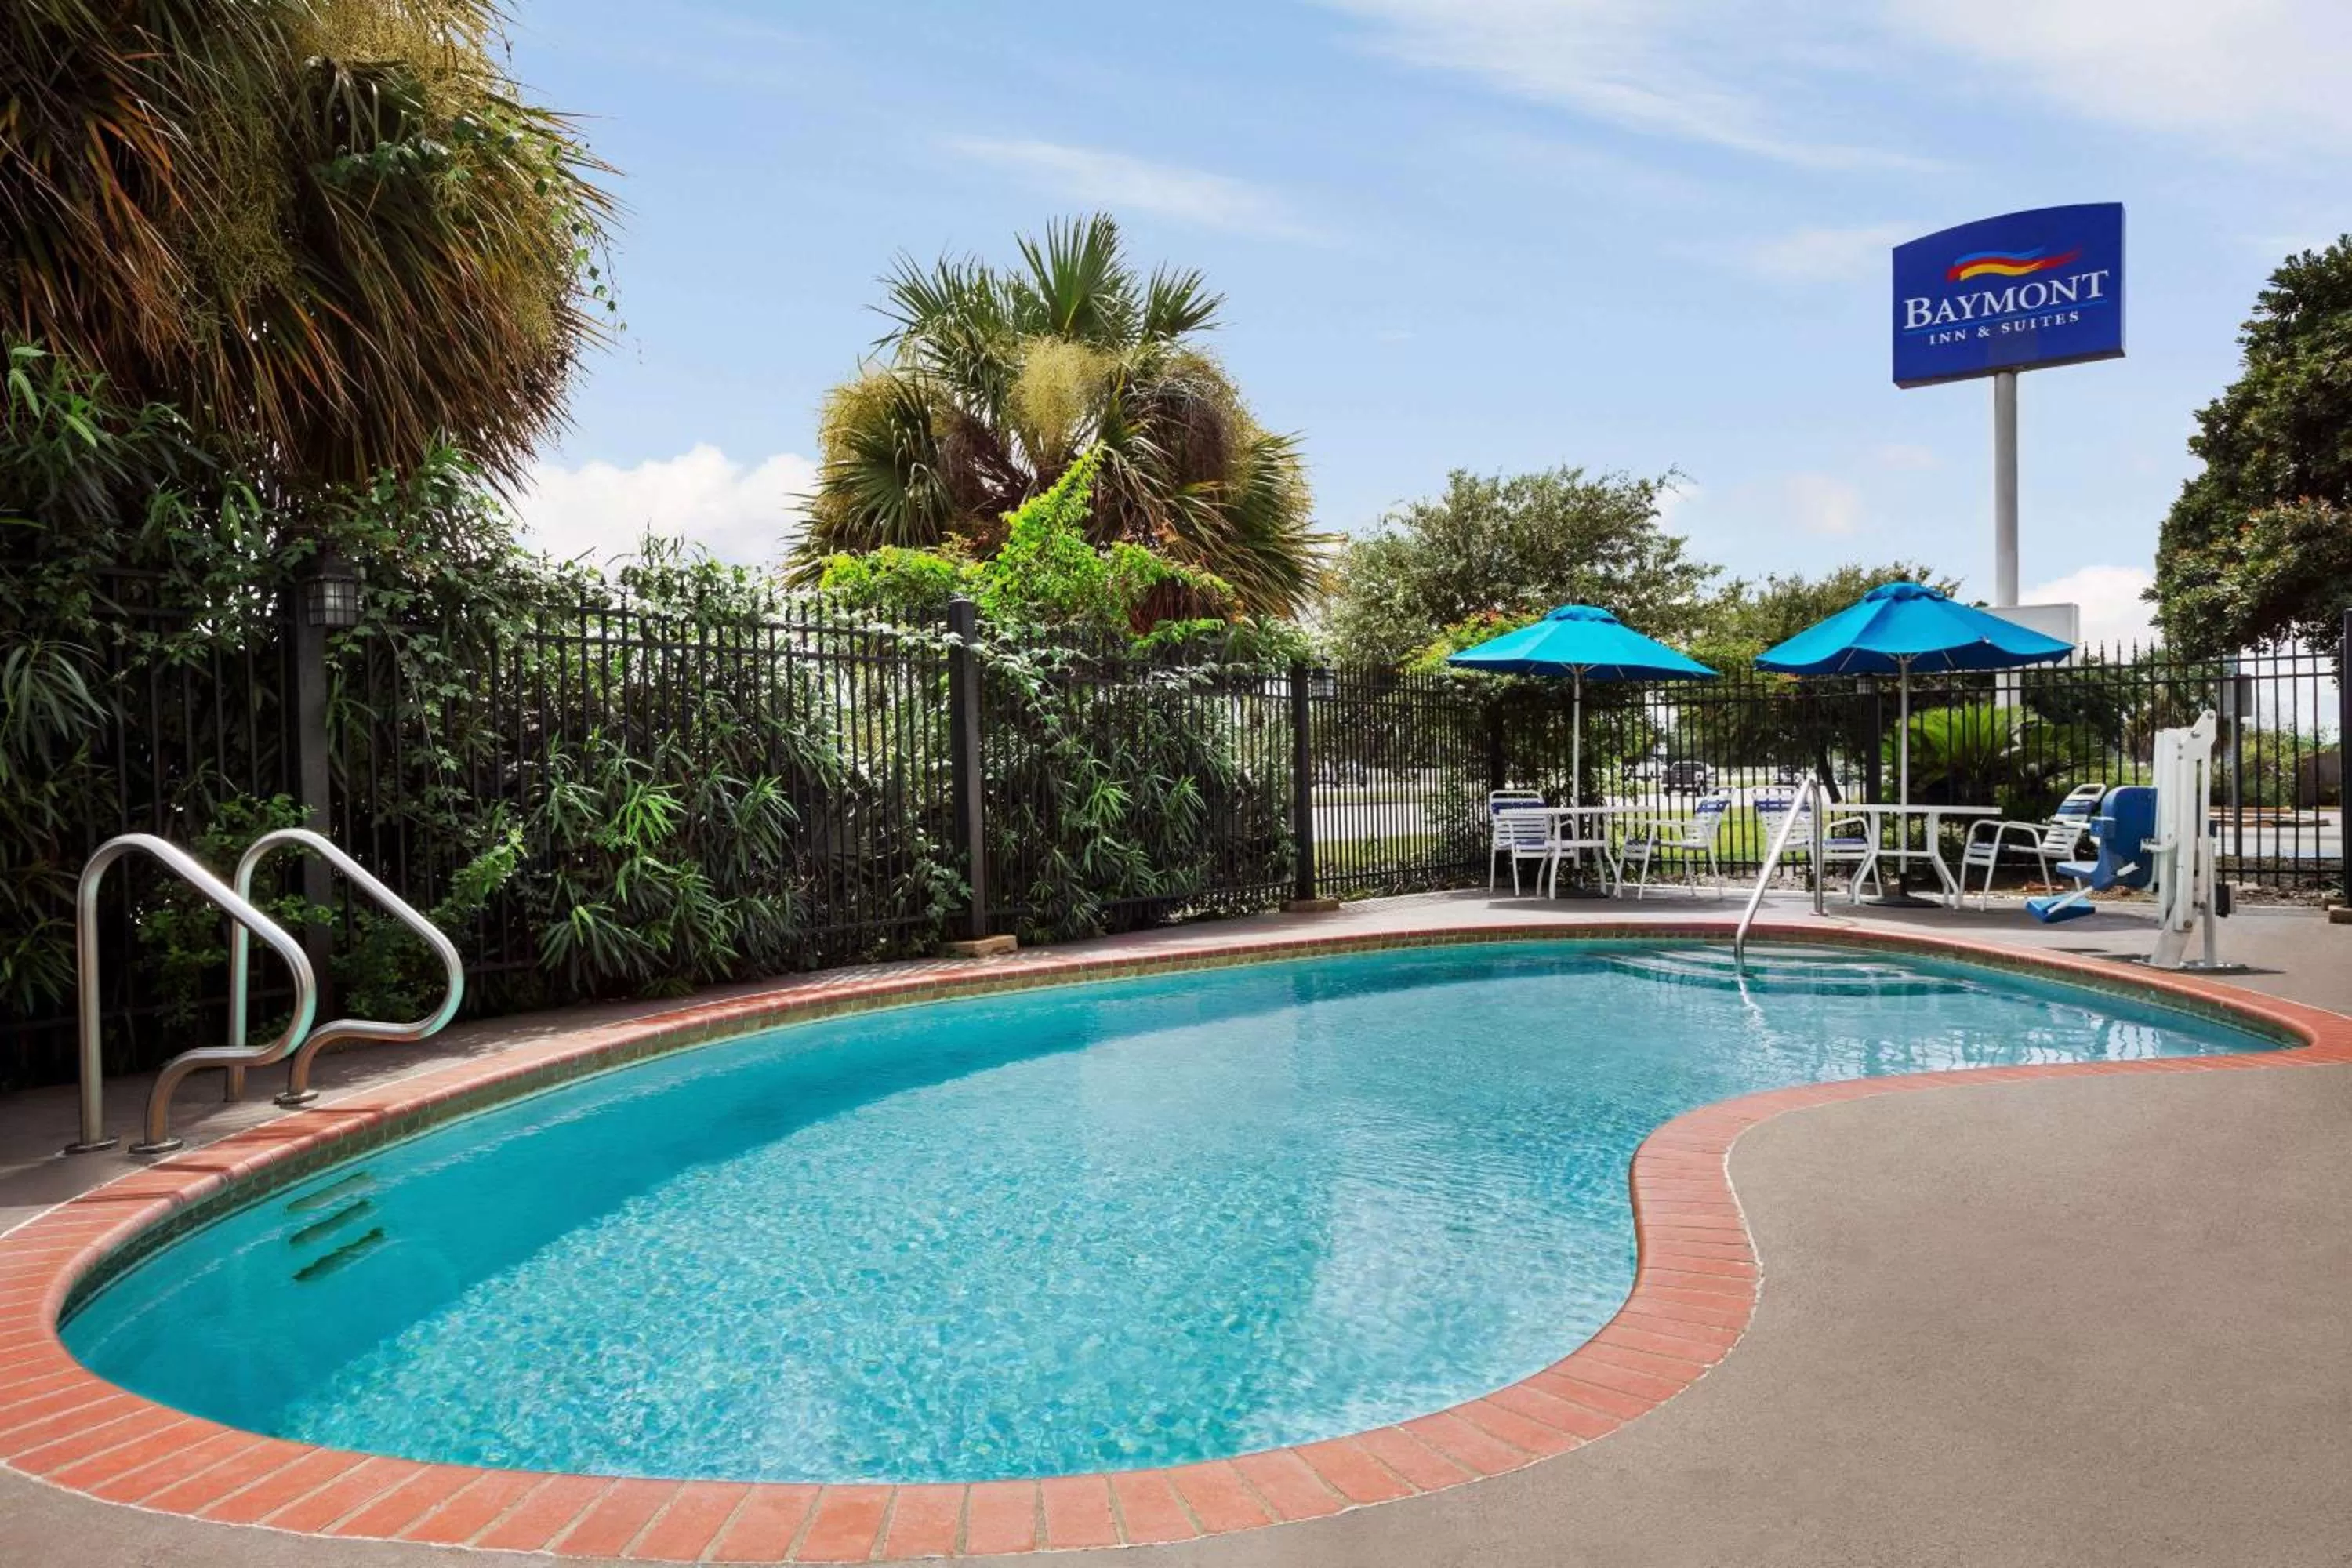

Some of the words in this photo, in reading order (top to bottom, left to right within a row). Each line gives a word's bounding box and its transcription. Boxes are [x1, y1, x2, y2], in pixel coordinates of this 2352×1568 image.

[1904, 270, 2109, 329] BAYMONT
[1929, 328, 1966, 345] INN
[1977, 325, 1991, 339] &
[2001, 311, 2080, 334] SUITES
